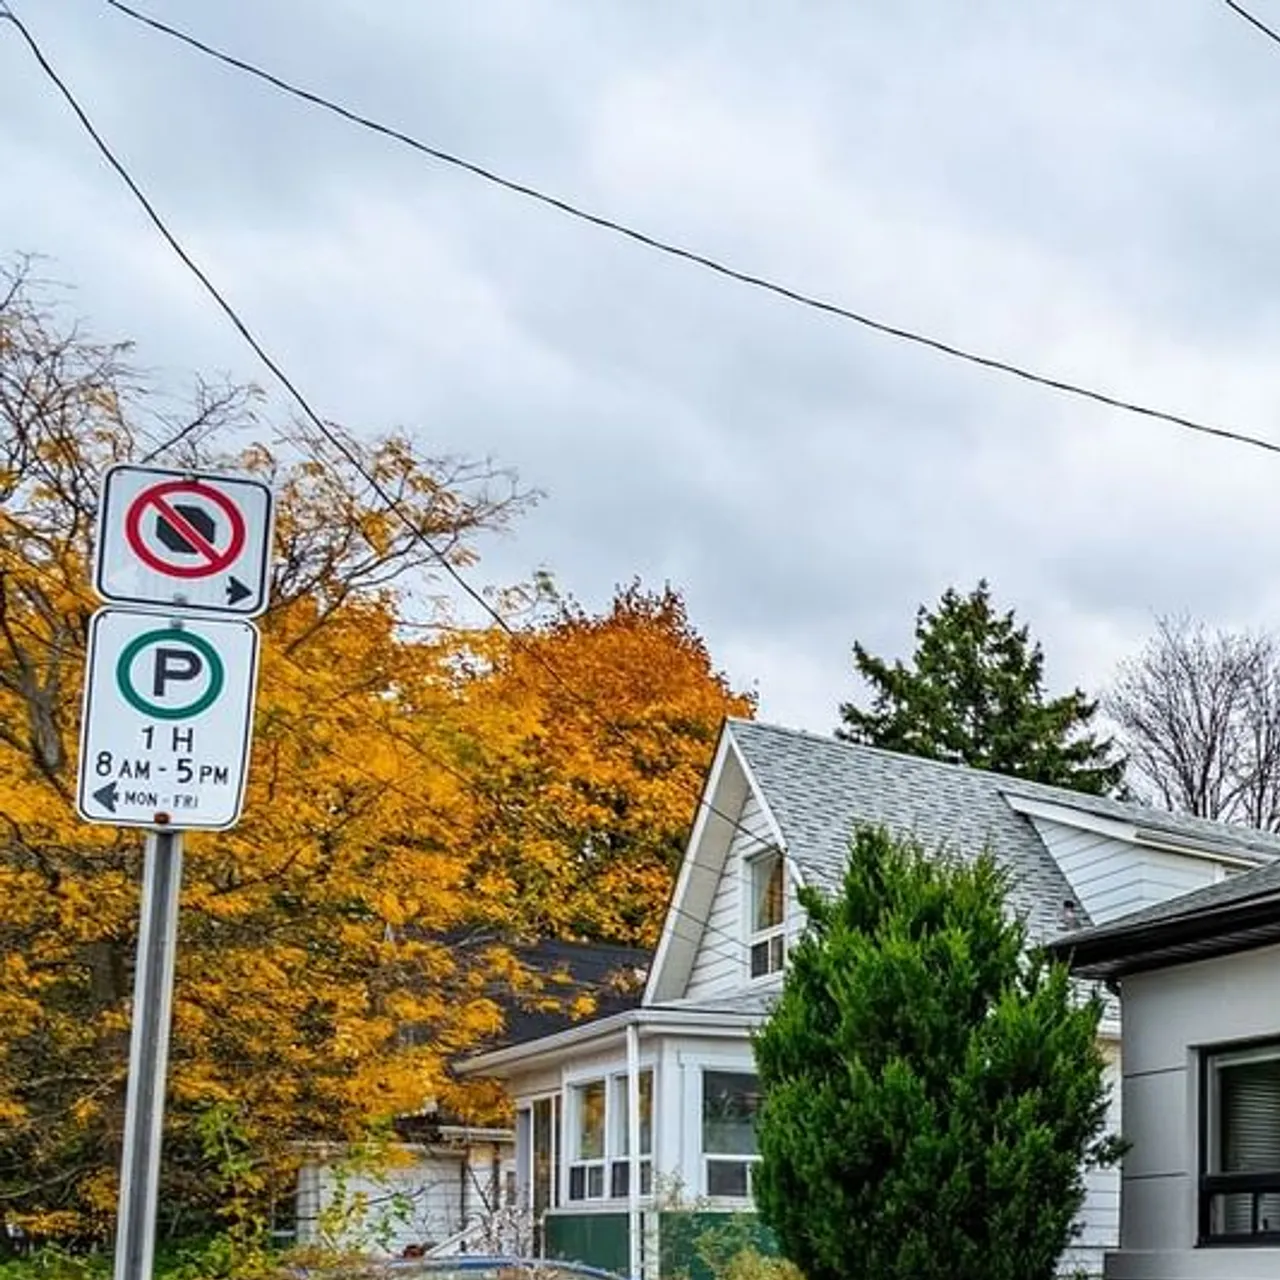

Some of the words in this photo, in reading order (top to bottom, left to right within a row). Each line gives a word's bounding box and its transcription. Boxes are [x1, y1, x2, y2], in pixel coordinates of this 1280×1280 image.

[153, 647, 203, 697] P
[142, 725, 155, 750] 1
[172, 727, 194, 753] H
